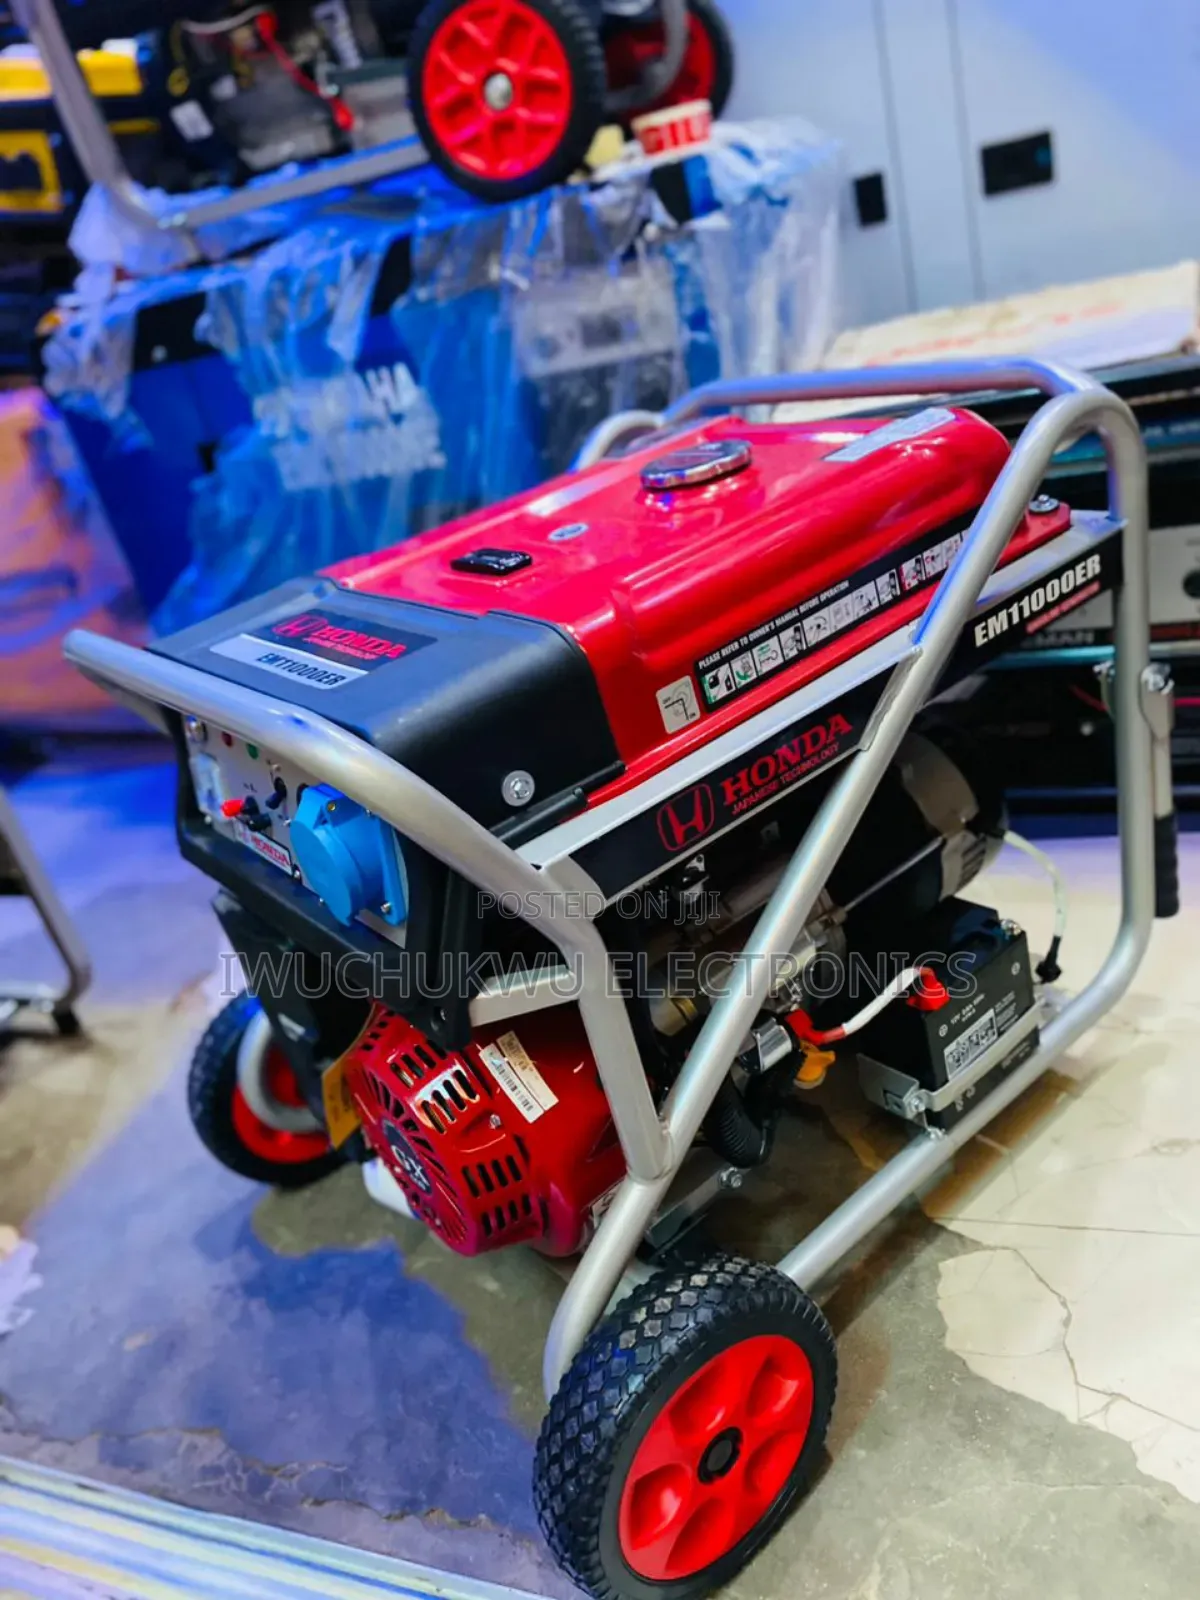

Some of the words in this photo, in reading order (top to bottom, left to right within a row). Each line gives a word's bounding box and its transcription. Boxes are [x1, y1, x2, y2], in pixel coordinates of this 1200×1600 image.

[698, 650, 721, 669] PLEASE
[721, 641, 740, 658] REFER
[740, 634, 749, 647] TO
[748, 622, 775, 641] OWNER'S
[774, 608, 800, 627] MANUAL
[800, 596, 820, 614] BEFORE
[819, 579, 850, 603] OPERATION
[973, 553, 1101, 648] EM11000ER
[310, 625, 407, 659] HONDA
[719, 713, 854, 807] HONDA
[731, 781, 779, 815] JAPANESE
[780, 742, 840, 784] TECHNOLOGY
[391, 1144, 430, 1186] GX
